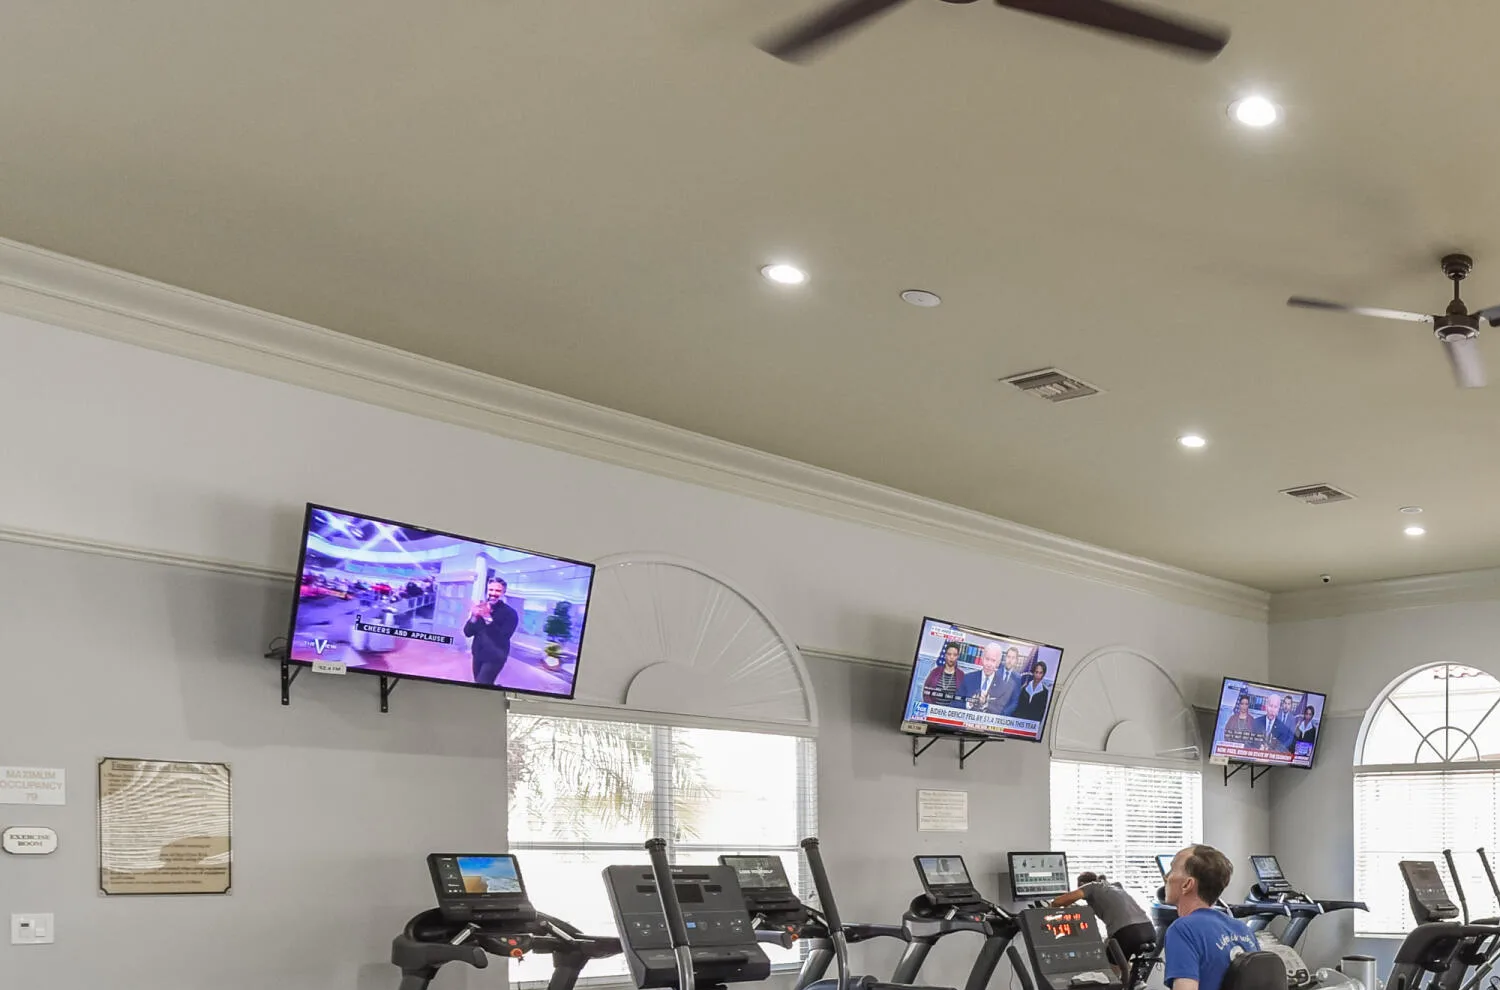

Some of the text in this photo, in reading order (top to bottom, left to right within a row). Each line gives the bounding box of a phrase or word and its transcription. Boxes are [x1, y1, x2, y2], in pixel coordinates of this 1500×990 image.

[363, 624, 445, 643] CHEERS AND APPLAUSE
[6, 769, 56, 779] MAXIMUM
[0, 780, 62, 790] OCCUPANCY
